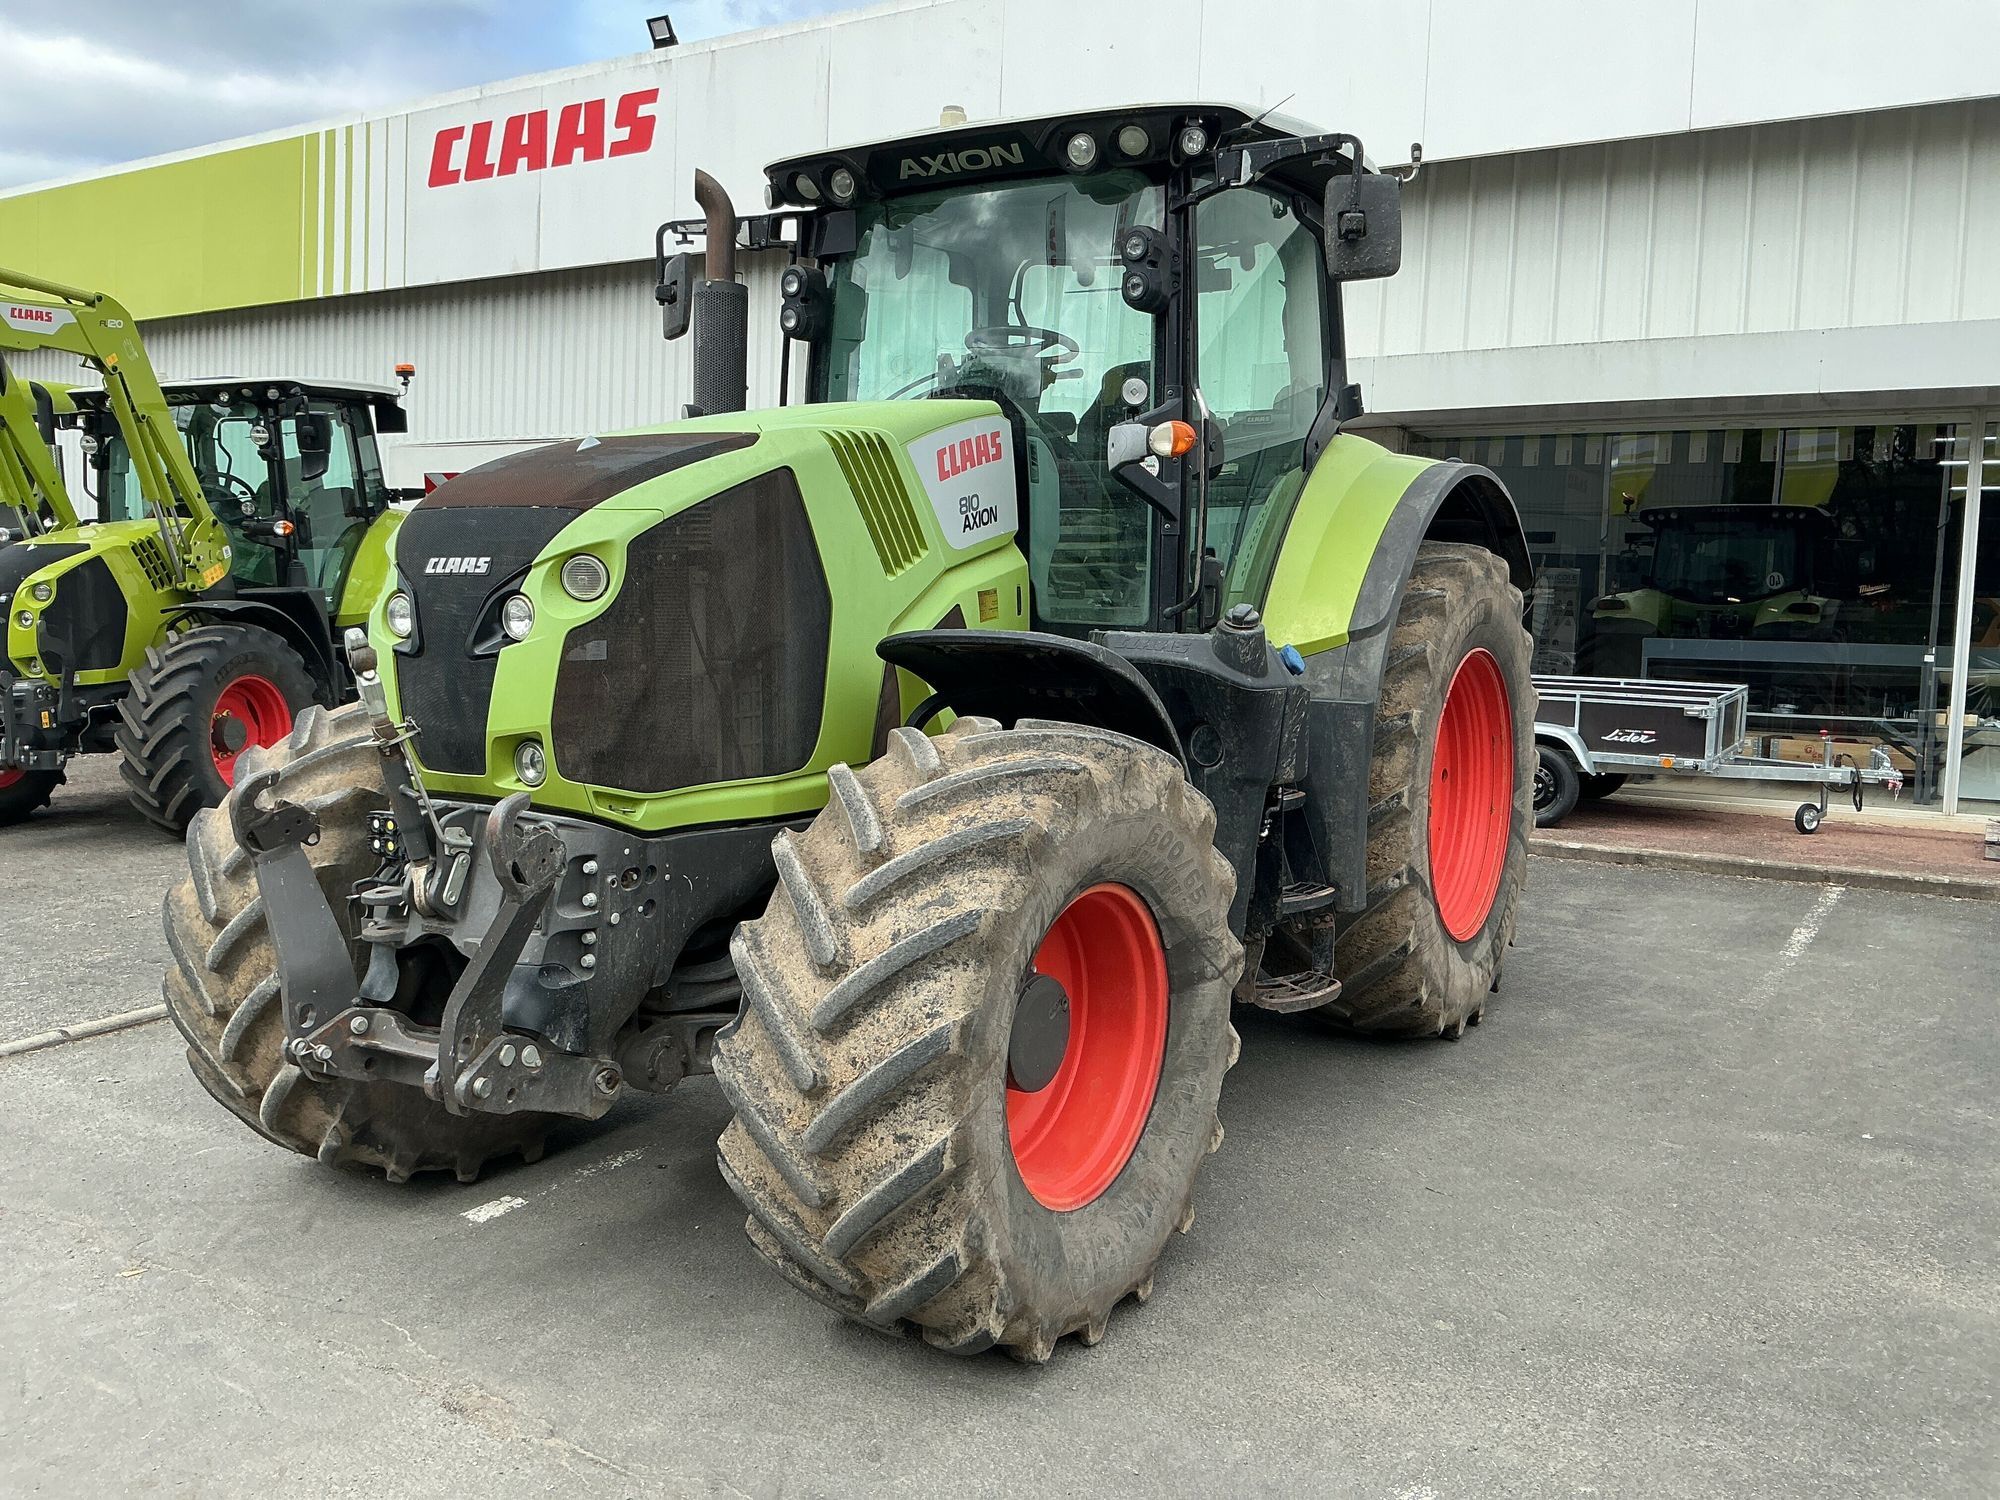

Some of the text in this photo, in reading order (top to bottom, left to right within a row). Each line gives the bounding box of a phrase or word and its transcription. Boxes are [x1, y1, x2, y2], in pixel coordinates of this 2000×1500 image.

[428, 88, 660, 188] CLAAS
[900, 143, 1024, 179] AXION
[10, 307, 53, 322] CLAAS
[937, 431, 1002, 482] CLAAS
[959, 494, 980, 515] 810
[963, 505, 998, 533] AXION
[425, 557, 491, 574] CLAAS
[1601, 729, 1656, 743] Lider
